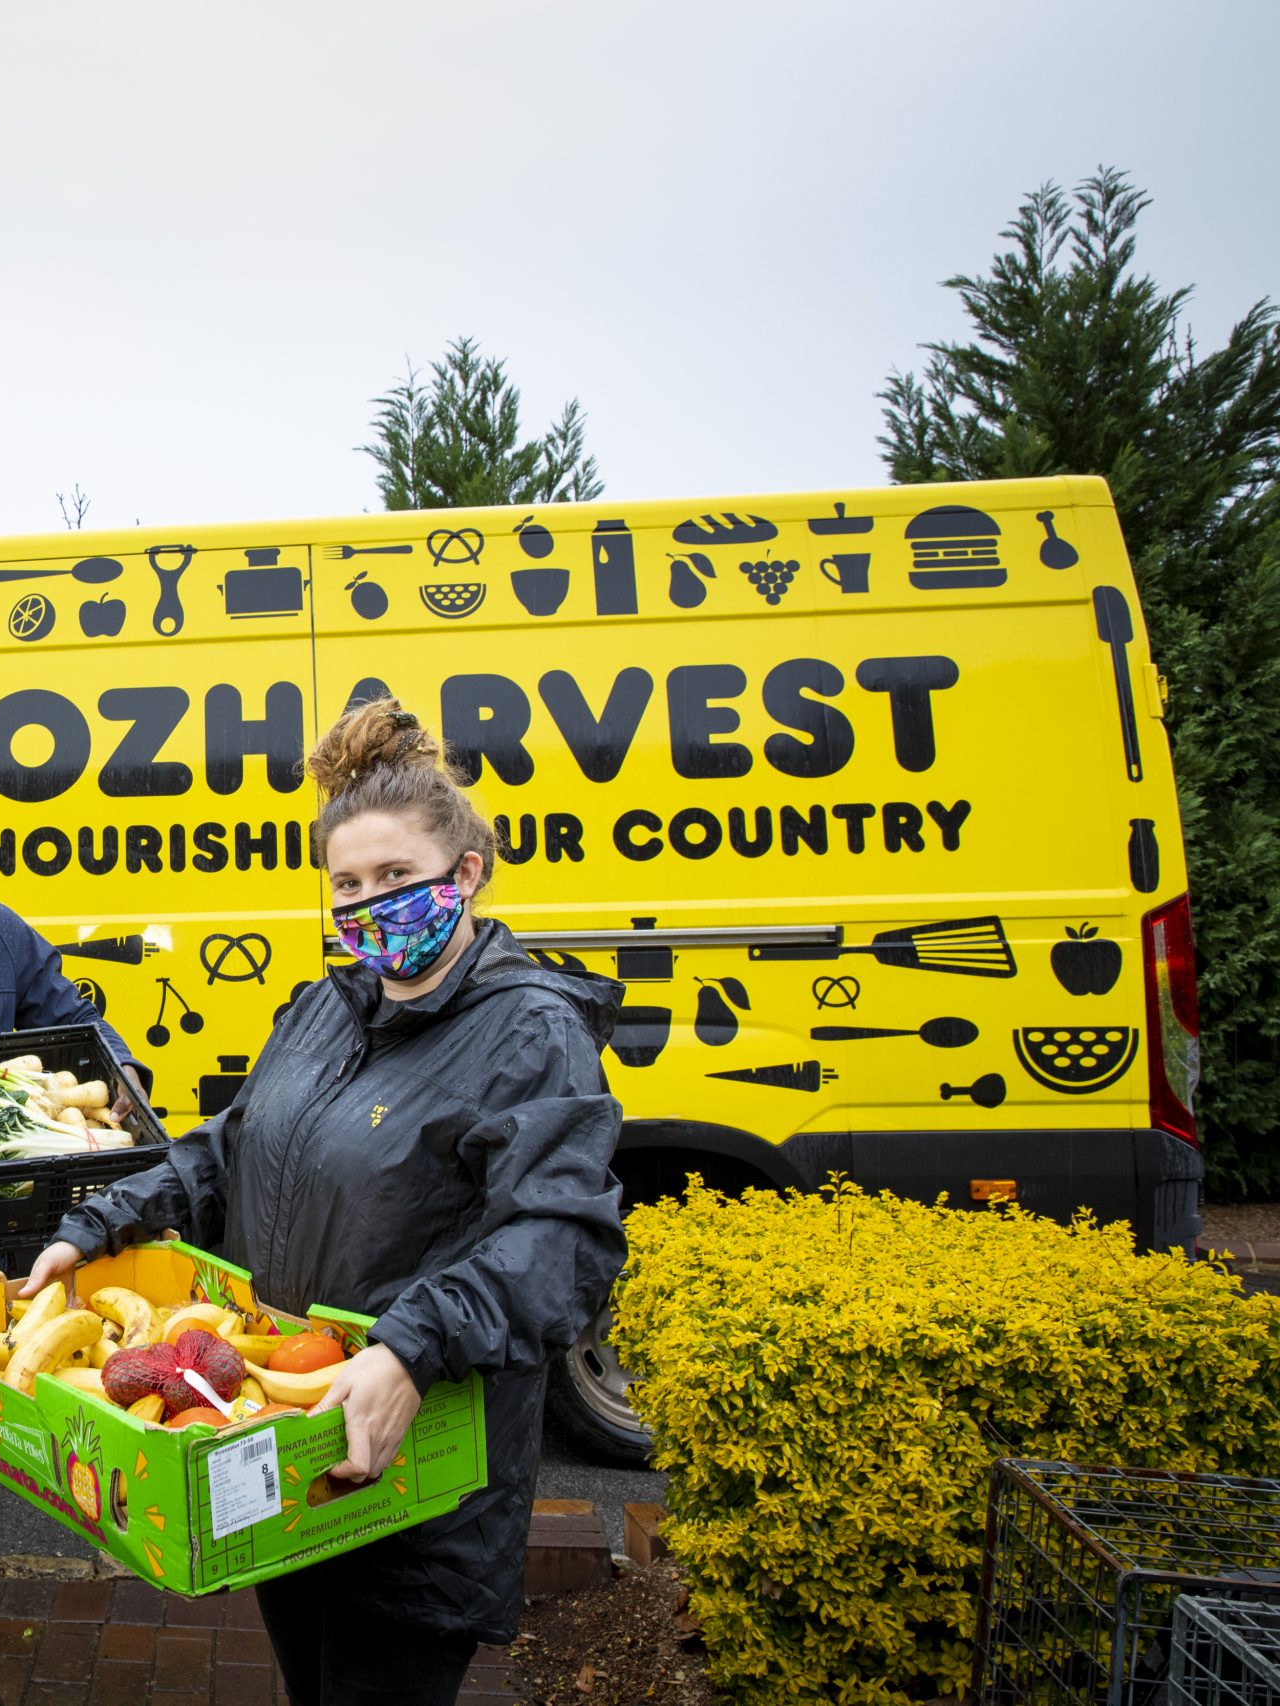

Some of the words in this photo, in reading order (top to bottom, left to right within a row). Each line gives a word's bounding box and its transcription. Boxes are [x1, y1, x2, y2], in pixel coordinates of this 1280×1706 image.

[493, 813, 585, 865] UR
[612, 799, 971, 862] COUNTRY
[418, 1424, 433, 1436] TOP
[435, 1419, 448, 1430] ON
[417, 1450, 445, 1465] PACKED
[446, 1444, 458, 1454] ON
[261, 1463, 269, 1474] 8
[300, 1517, 341, 1540] PREMIUM
[343, 1497, 392, 1524] PINEAPPLES
[282, 1537, 335, 1566] PRODUCT
[336, 1531, 351, 1546] OF
[353, 1509, 410, 1540] AUSTRALIA
[234, 1553, 246, 1565] 15
[212, 1564, 218, 1575] 9
